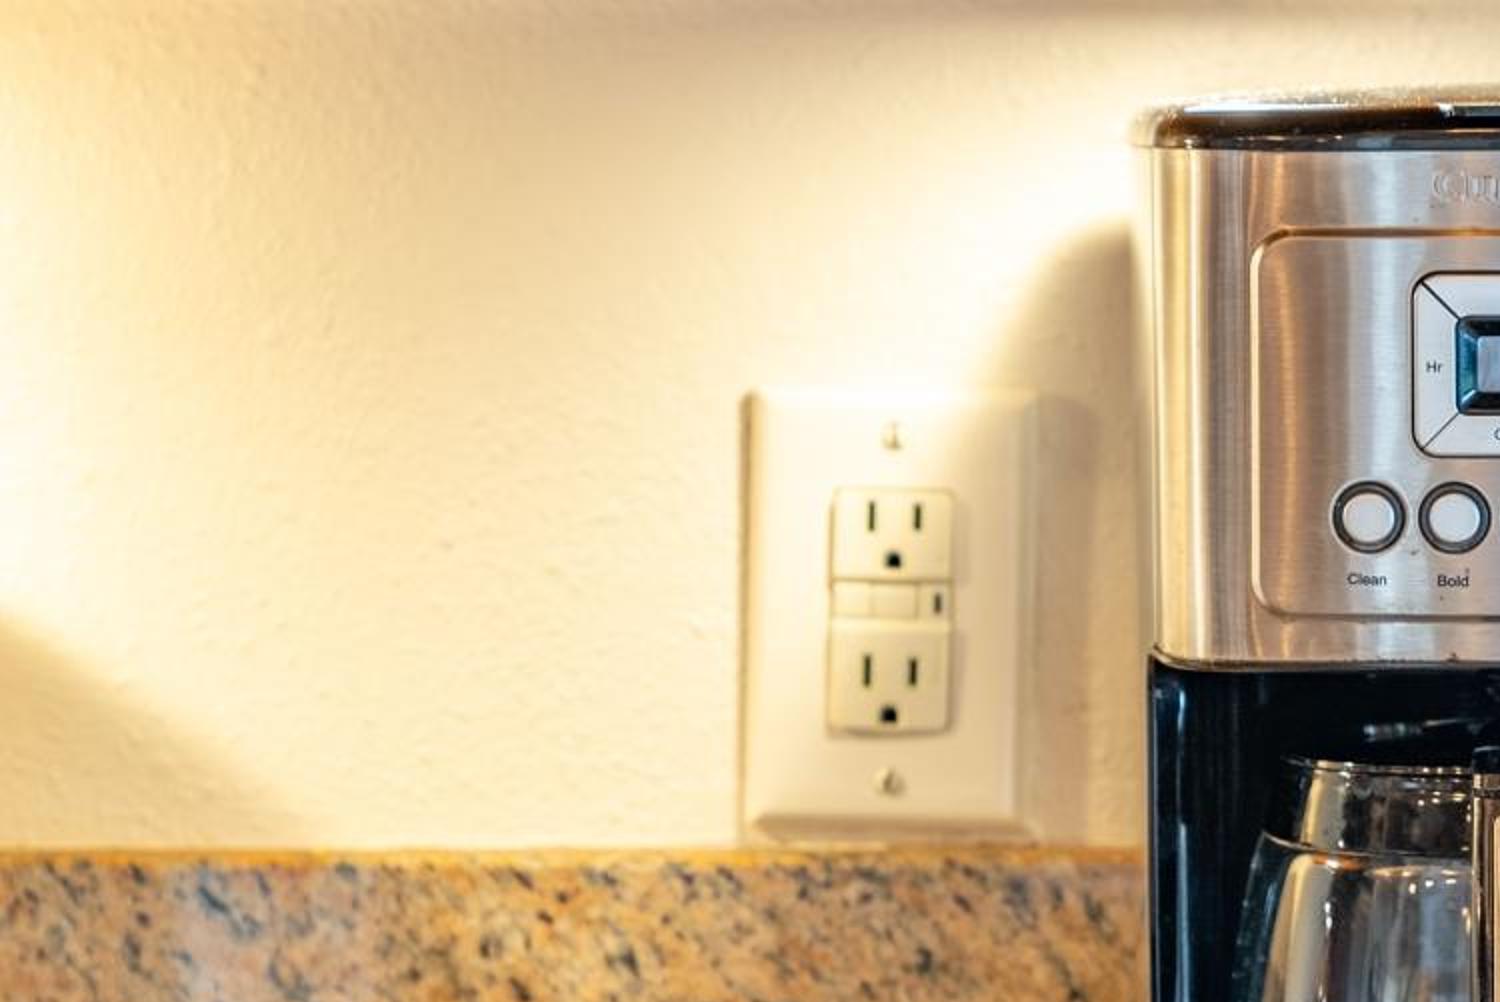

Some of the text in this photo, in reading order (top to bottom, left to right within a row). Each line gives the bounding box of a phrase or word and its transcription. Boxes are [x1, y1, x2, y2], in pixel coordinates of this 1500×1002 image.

[1426, 361, 1443, 373] Hr
[1347, 573, 1387, 586] Clean
[1437, 574, 1469, 587] Bold
